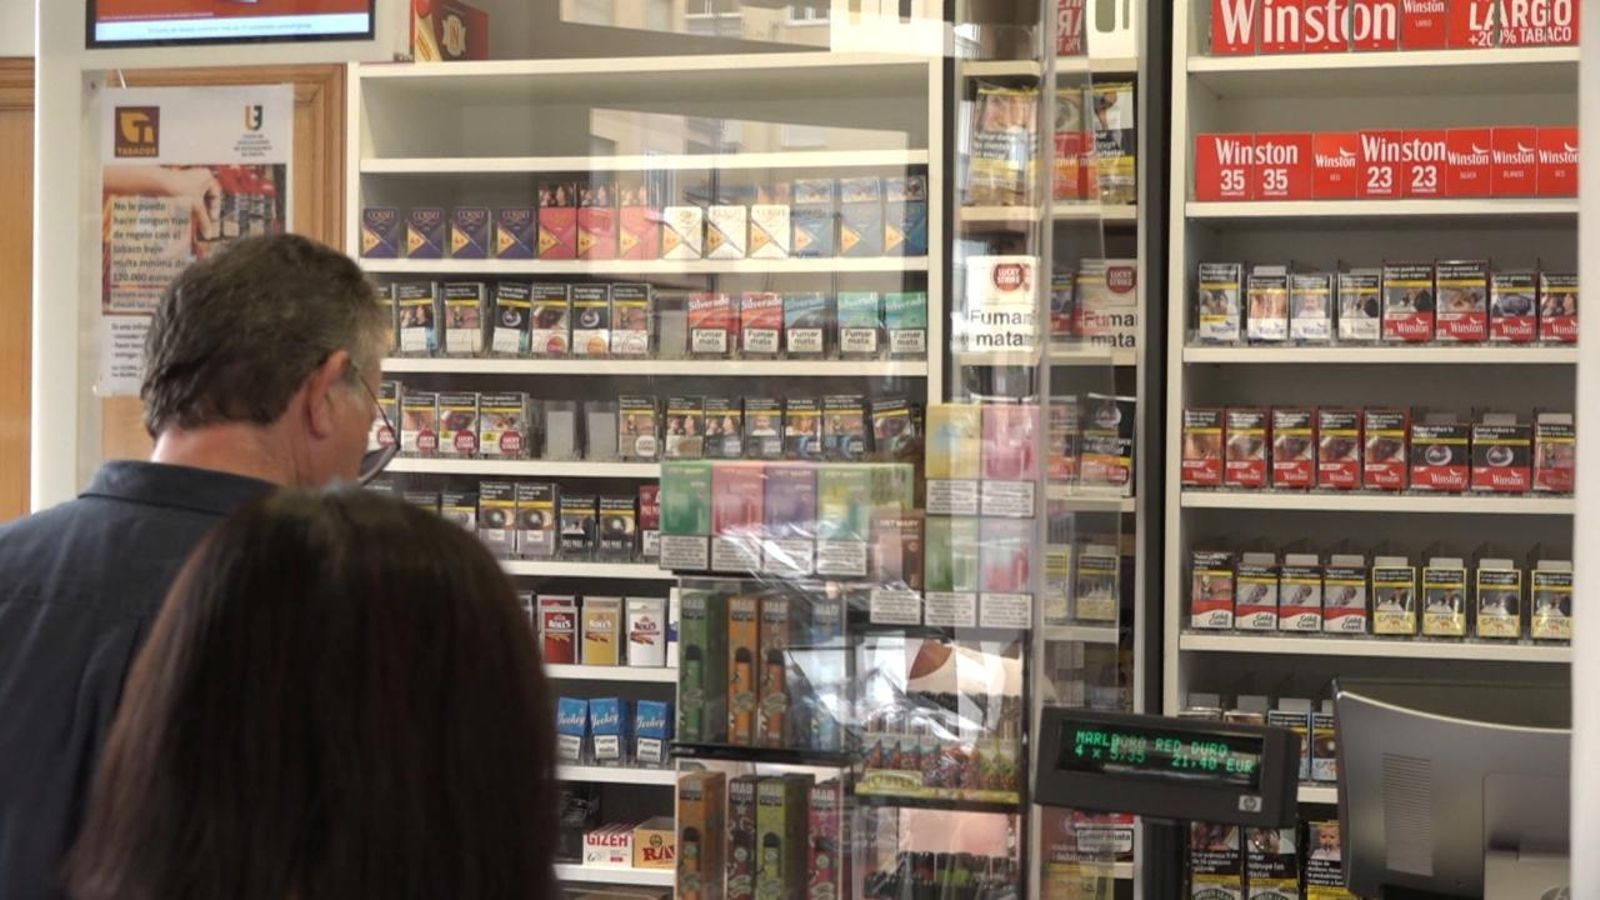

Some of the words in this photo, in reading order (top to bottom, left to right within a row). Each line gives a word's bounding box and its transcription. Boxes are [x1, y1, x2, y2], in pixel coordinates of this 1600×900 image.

[1403, 0, 1444, 13] Winston
[1220, 0, 1396, 44] Winston
[1470, 0, 1572, 31] LARGO
[1520, 27, 1572, 43] TABACO
[1215, 137, 1298, 165] Winston
[1361, 134, 1445, 162] Winston
[1315, 153, 1355, 168] Winston
[1447, 151, 1489, 165] Winston
[1492, 150, 1534, 164] Winston
[1220, 169, 1245, 190] 35
[1263, 169, 1288, 190] 35
[1367, 166, 1392, 188] 23
[1412, 165, 1437, 187] 23
[998, 269, 1019, 277] LUCKY
[748, 330, 774, 339] Fumar
[845, 330, 872, 338] Fumar
[894, 330, 921, 339] Fumar
[1450, 321, 1483, 334] Winston
[696, 331, 723, 339] Fumar
[699, 337, 719, 345] mata
[751, 337, 772, 345] mata
[791, 331, 819, 339] Fumar
[795, 337, 816, 345] mata
[847, 337, 870, 345] mata
[976, 331, 1024, 346] mata
[1091, 333, 1136, 347] mata
[1431, 472, 1462, 485] Winston
[1492, 473, 1524, 485] Winston
[1155, 738, 1182, 753] RED
[1074, 745, 1083, 758] 4
[1225, 759, 1255, 773] EUR
[586, 832, 628, 847] GIZEH
[1106, 832, 1131, 841] mata
